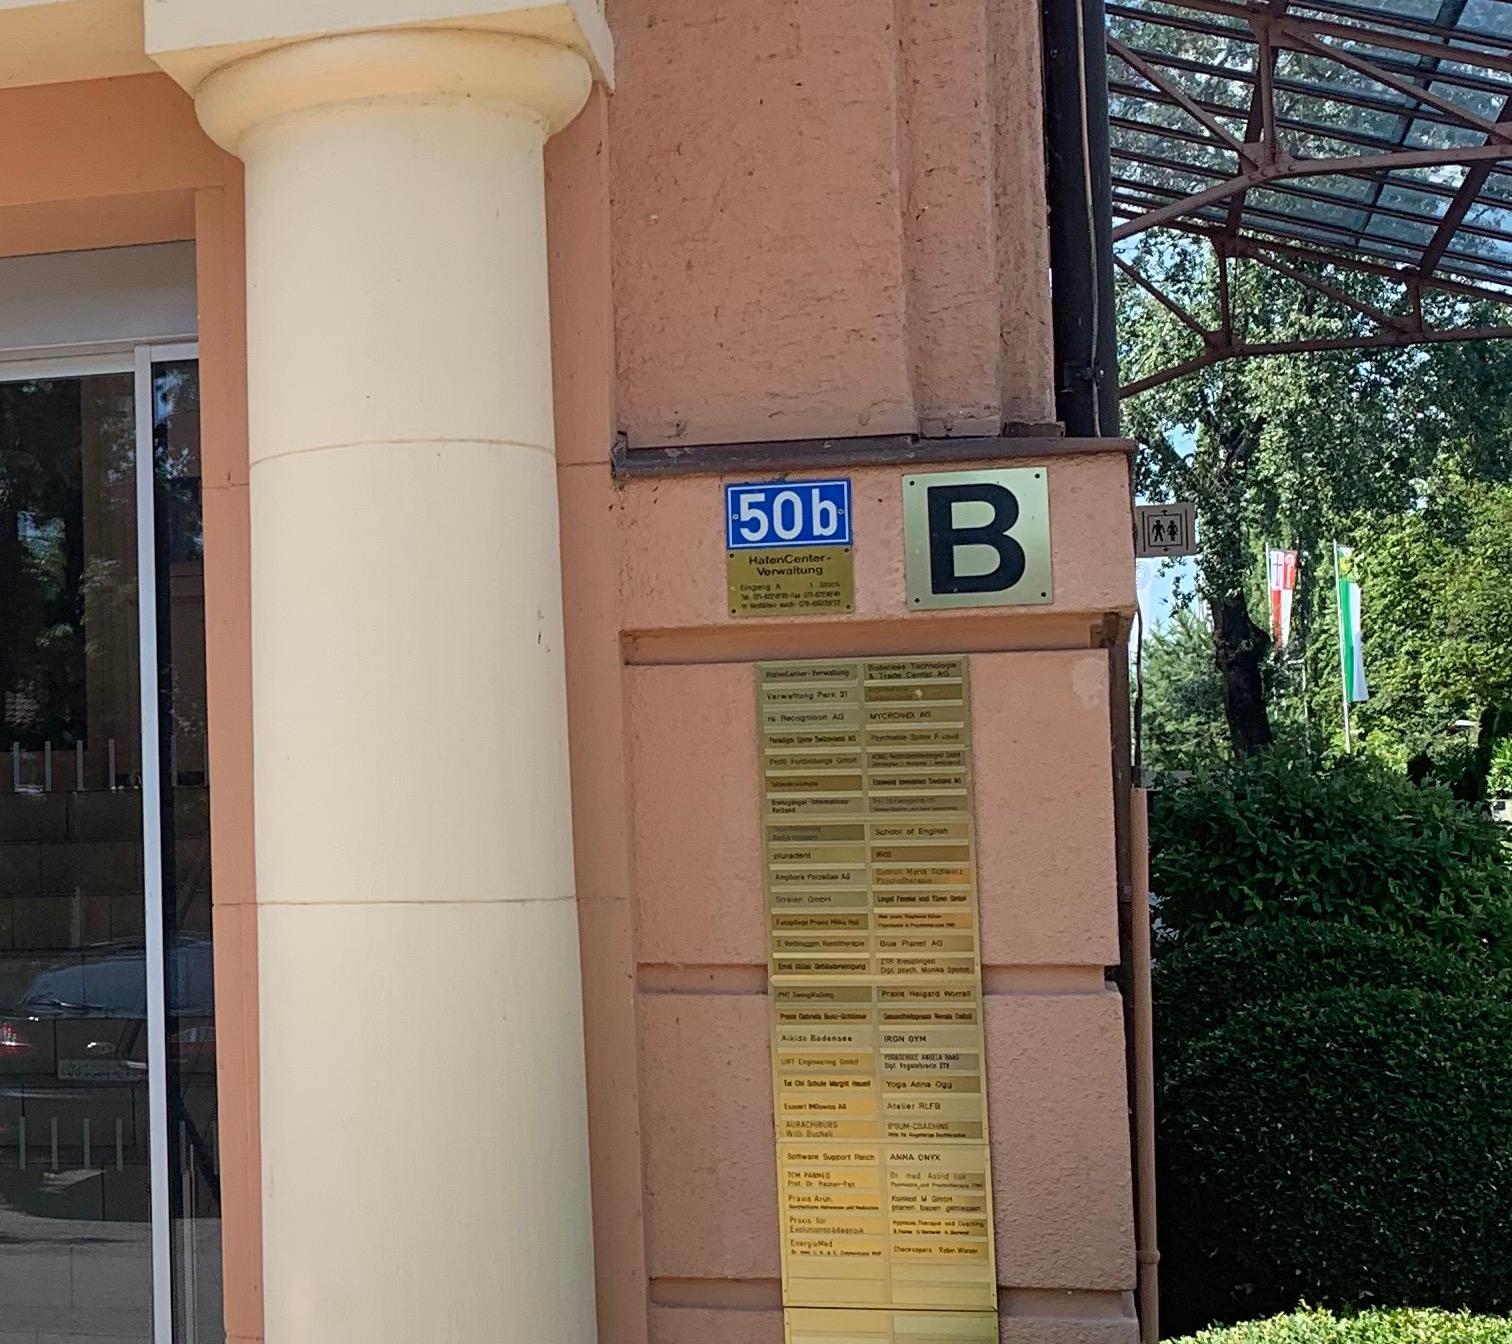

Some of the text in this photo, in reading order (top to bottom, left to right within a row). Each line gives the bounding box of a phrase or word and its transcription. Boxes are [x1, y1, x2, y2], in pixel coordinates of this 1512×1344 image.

[740, 488, 838, 542] 50b
[927, 483, 1026, 594] B
[749, 554, 831, 565] HafenCenter-
[757, 566, 823, 576] Verwaltung
[918, 828, 948, 836] English
[931, 939, 943, 947] AG
[810, 1034, 852, 1042] Bodensee
[886, 1081, 907, 1089] Yoga
[823, 1153, 851, 1161] Support
